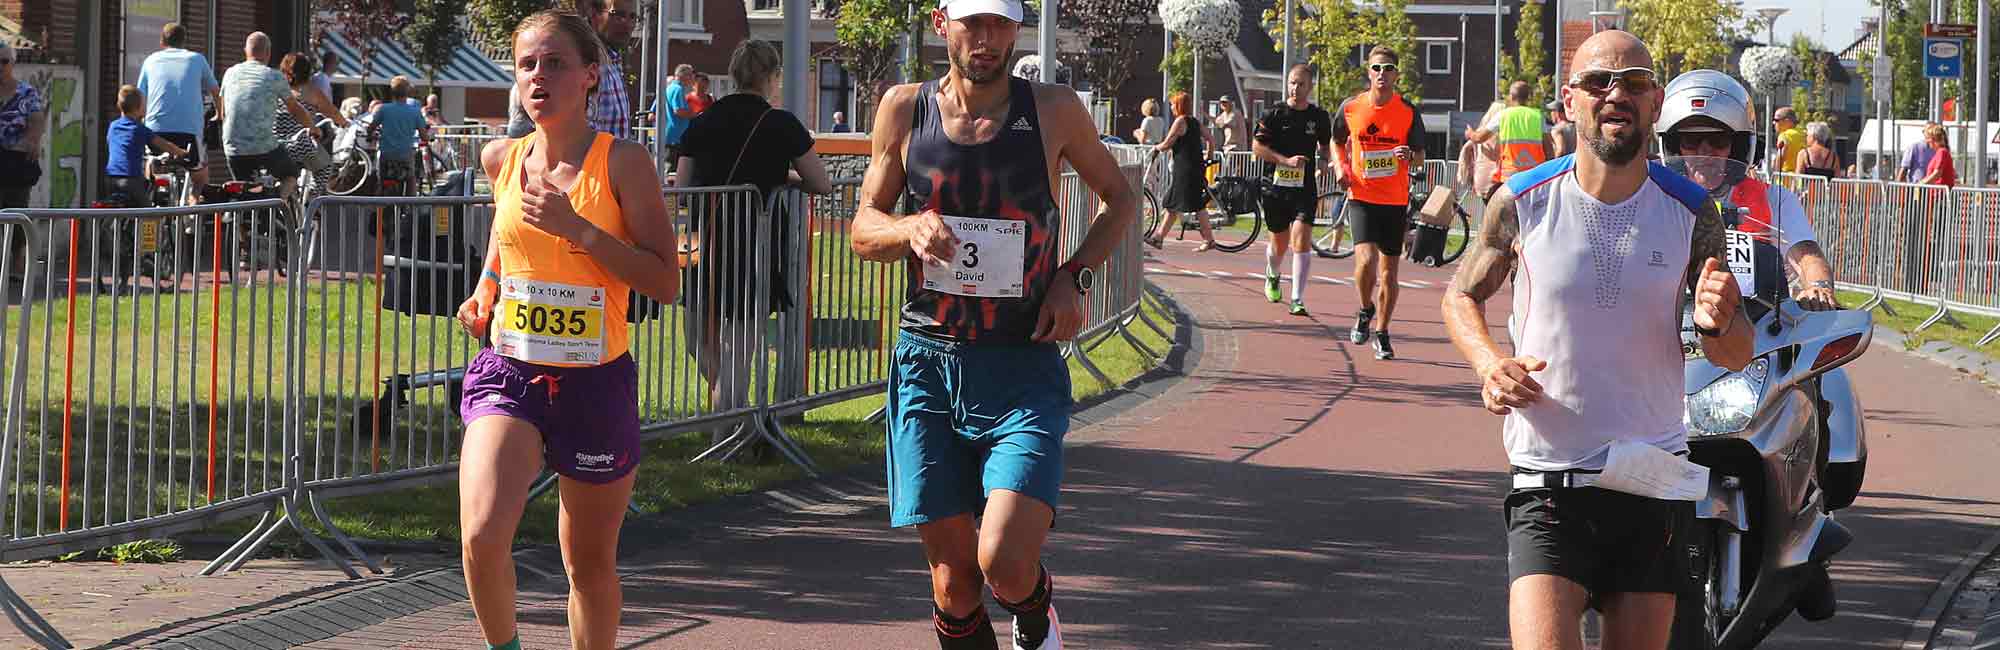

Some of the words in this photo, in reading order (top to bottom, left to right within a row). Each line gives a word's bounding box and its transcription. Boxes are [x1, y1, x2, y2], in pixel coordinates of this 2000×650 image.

[1367, 158, 1393, 169] 3684
[959, 222, 989, 232] 100KM
[961, 243, 979, 268] 3
[956, 271, 985, 281] David
[527, 285, 536, 295] 10
[547, 287, 557, 297] 10
[559, 289, 576, 298] KM
[515, 303, 587, 335] 5035
